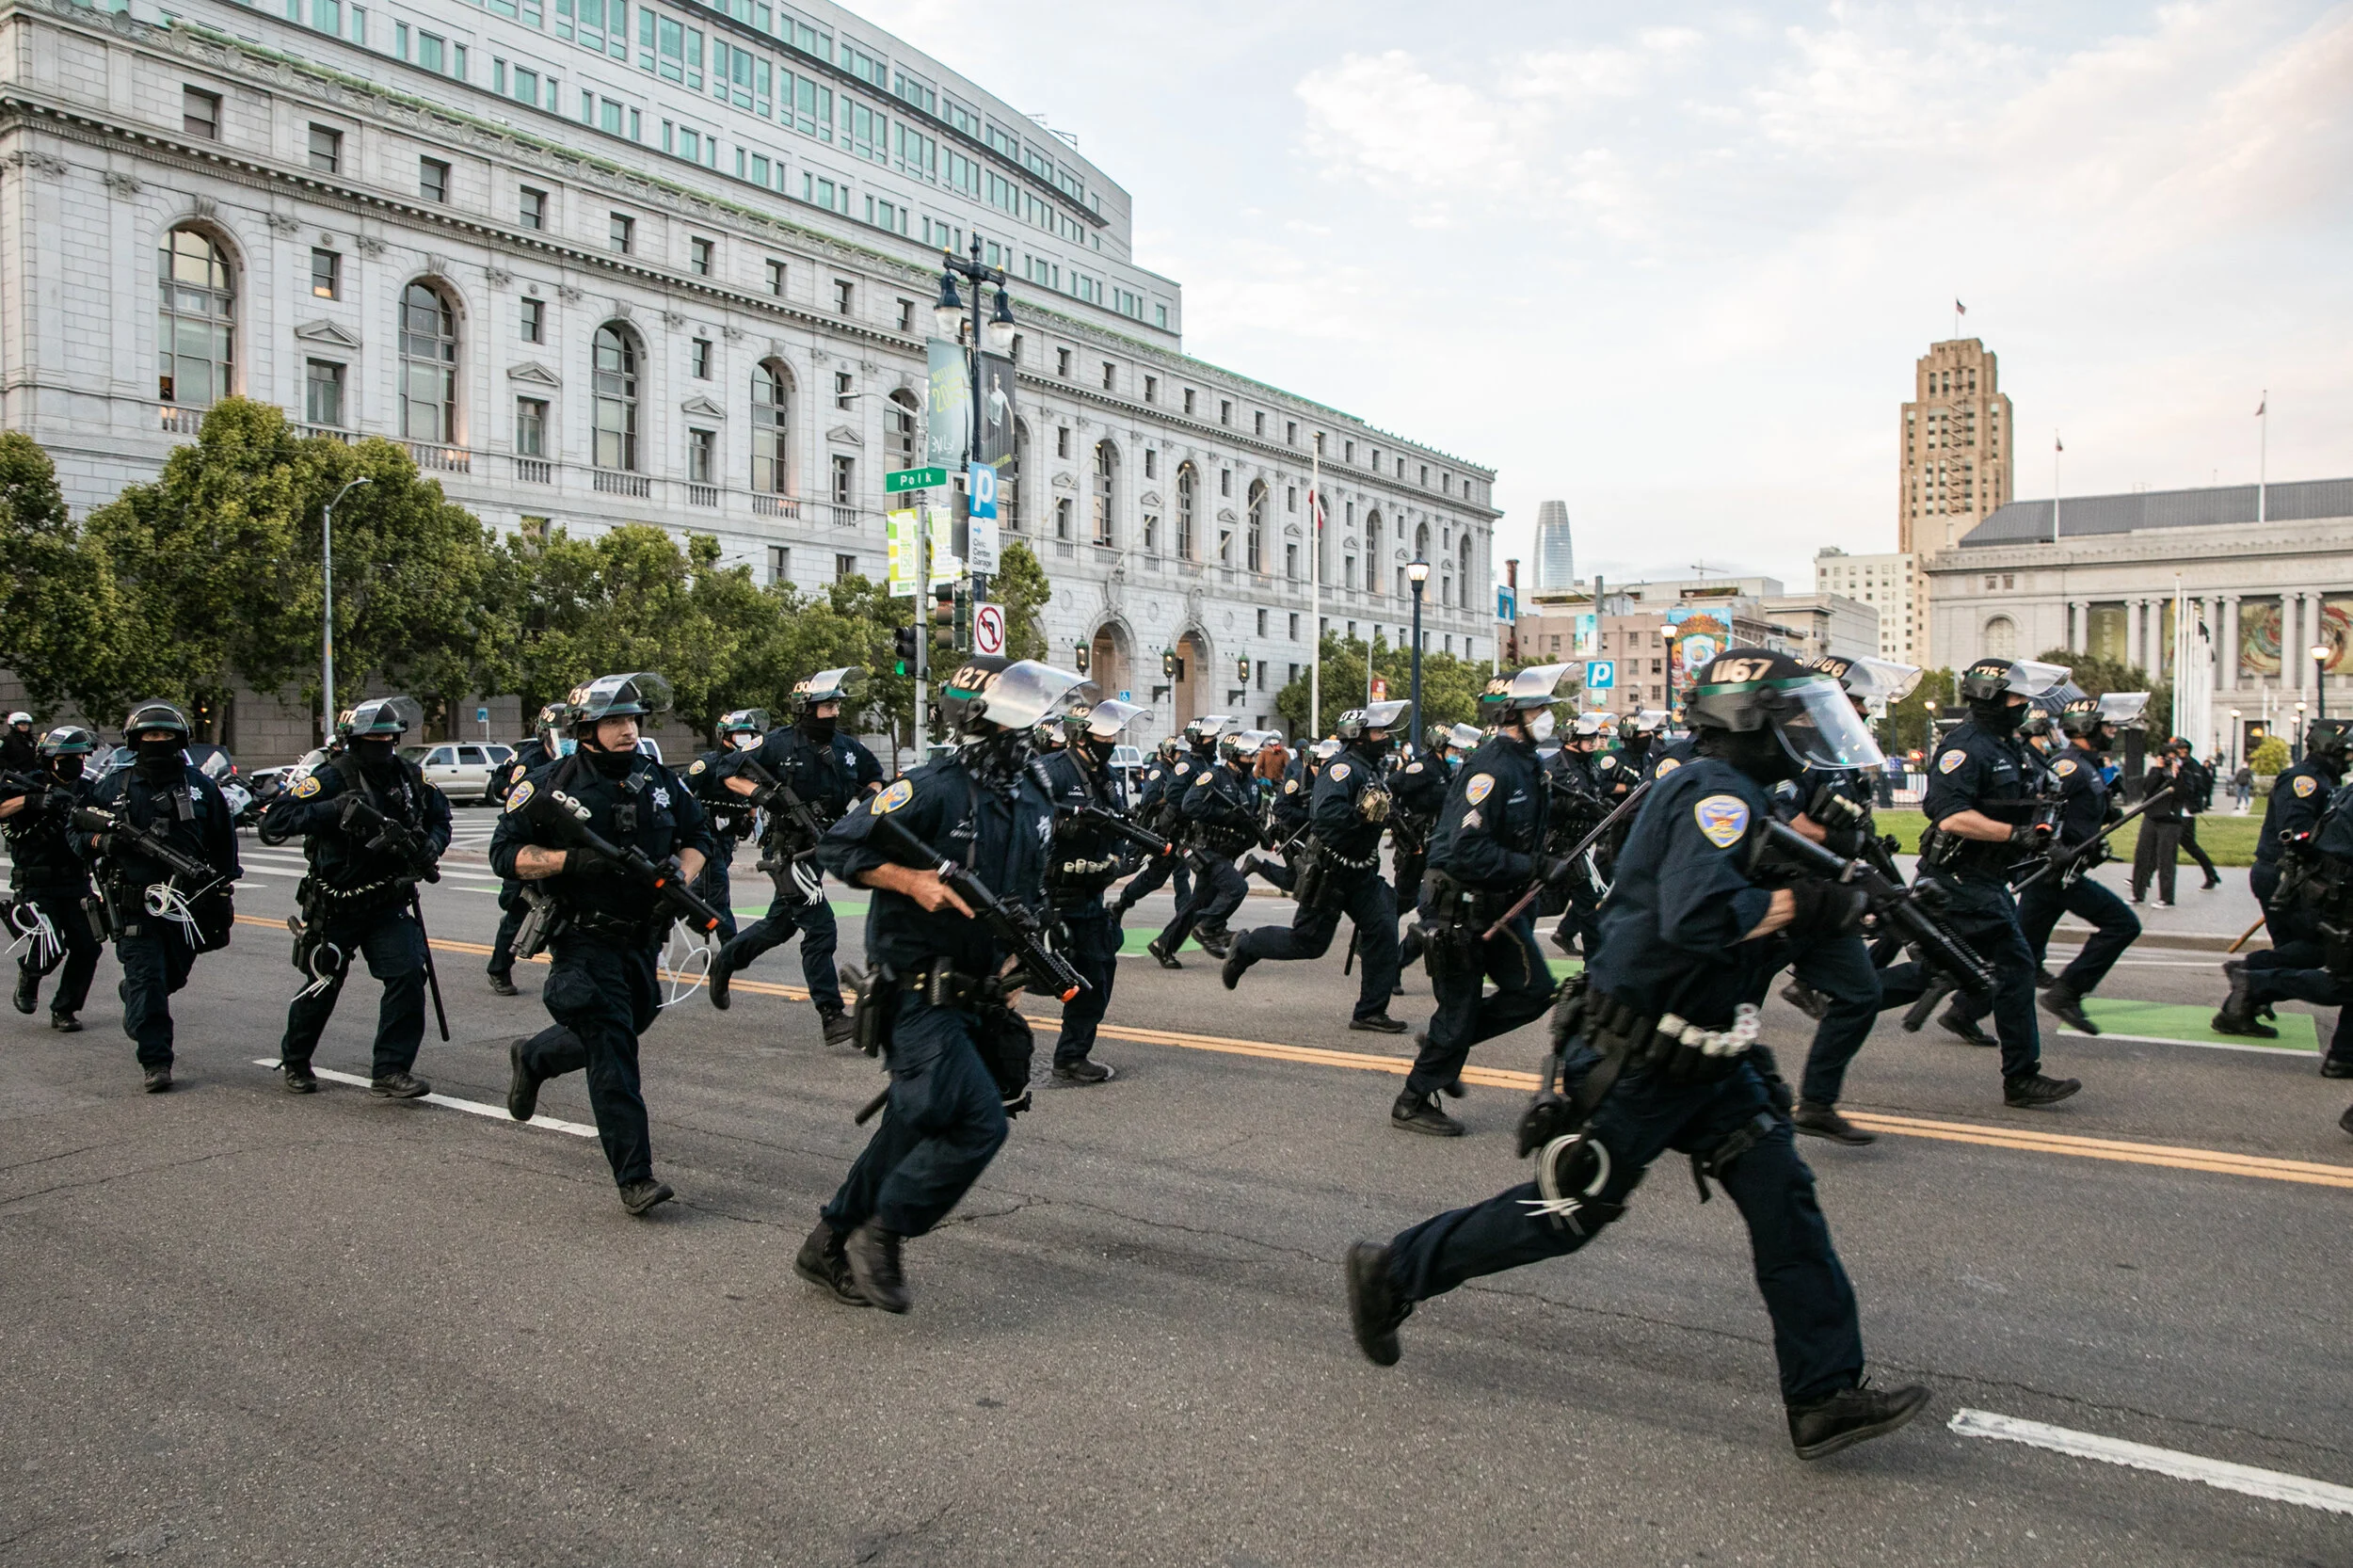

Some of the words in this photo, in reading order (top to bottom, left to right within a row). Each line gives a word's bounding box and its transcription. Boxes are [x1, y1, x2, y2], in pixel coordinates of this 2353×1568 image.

[900, 472, 932, 487] Polk
[972, 537, 986, 549] Civic
[972, 548, 991, 558] Center
[972, 558, 993, 568] Garage
[2063, 700, 2098, 713] 2447
